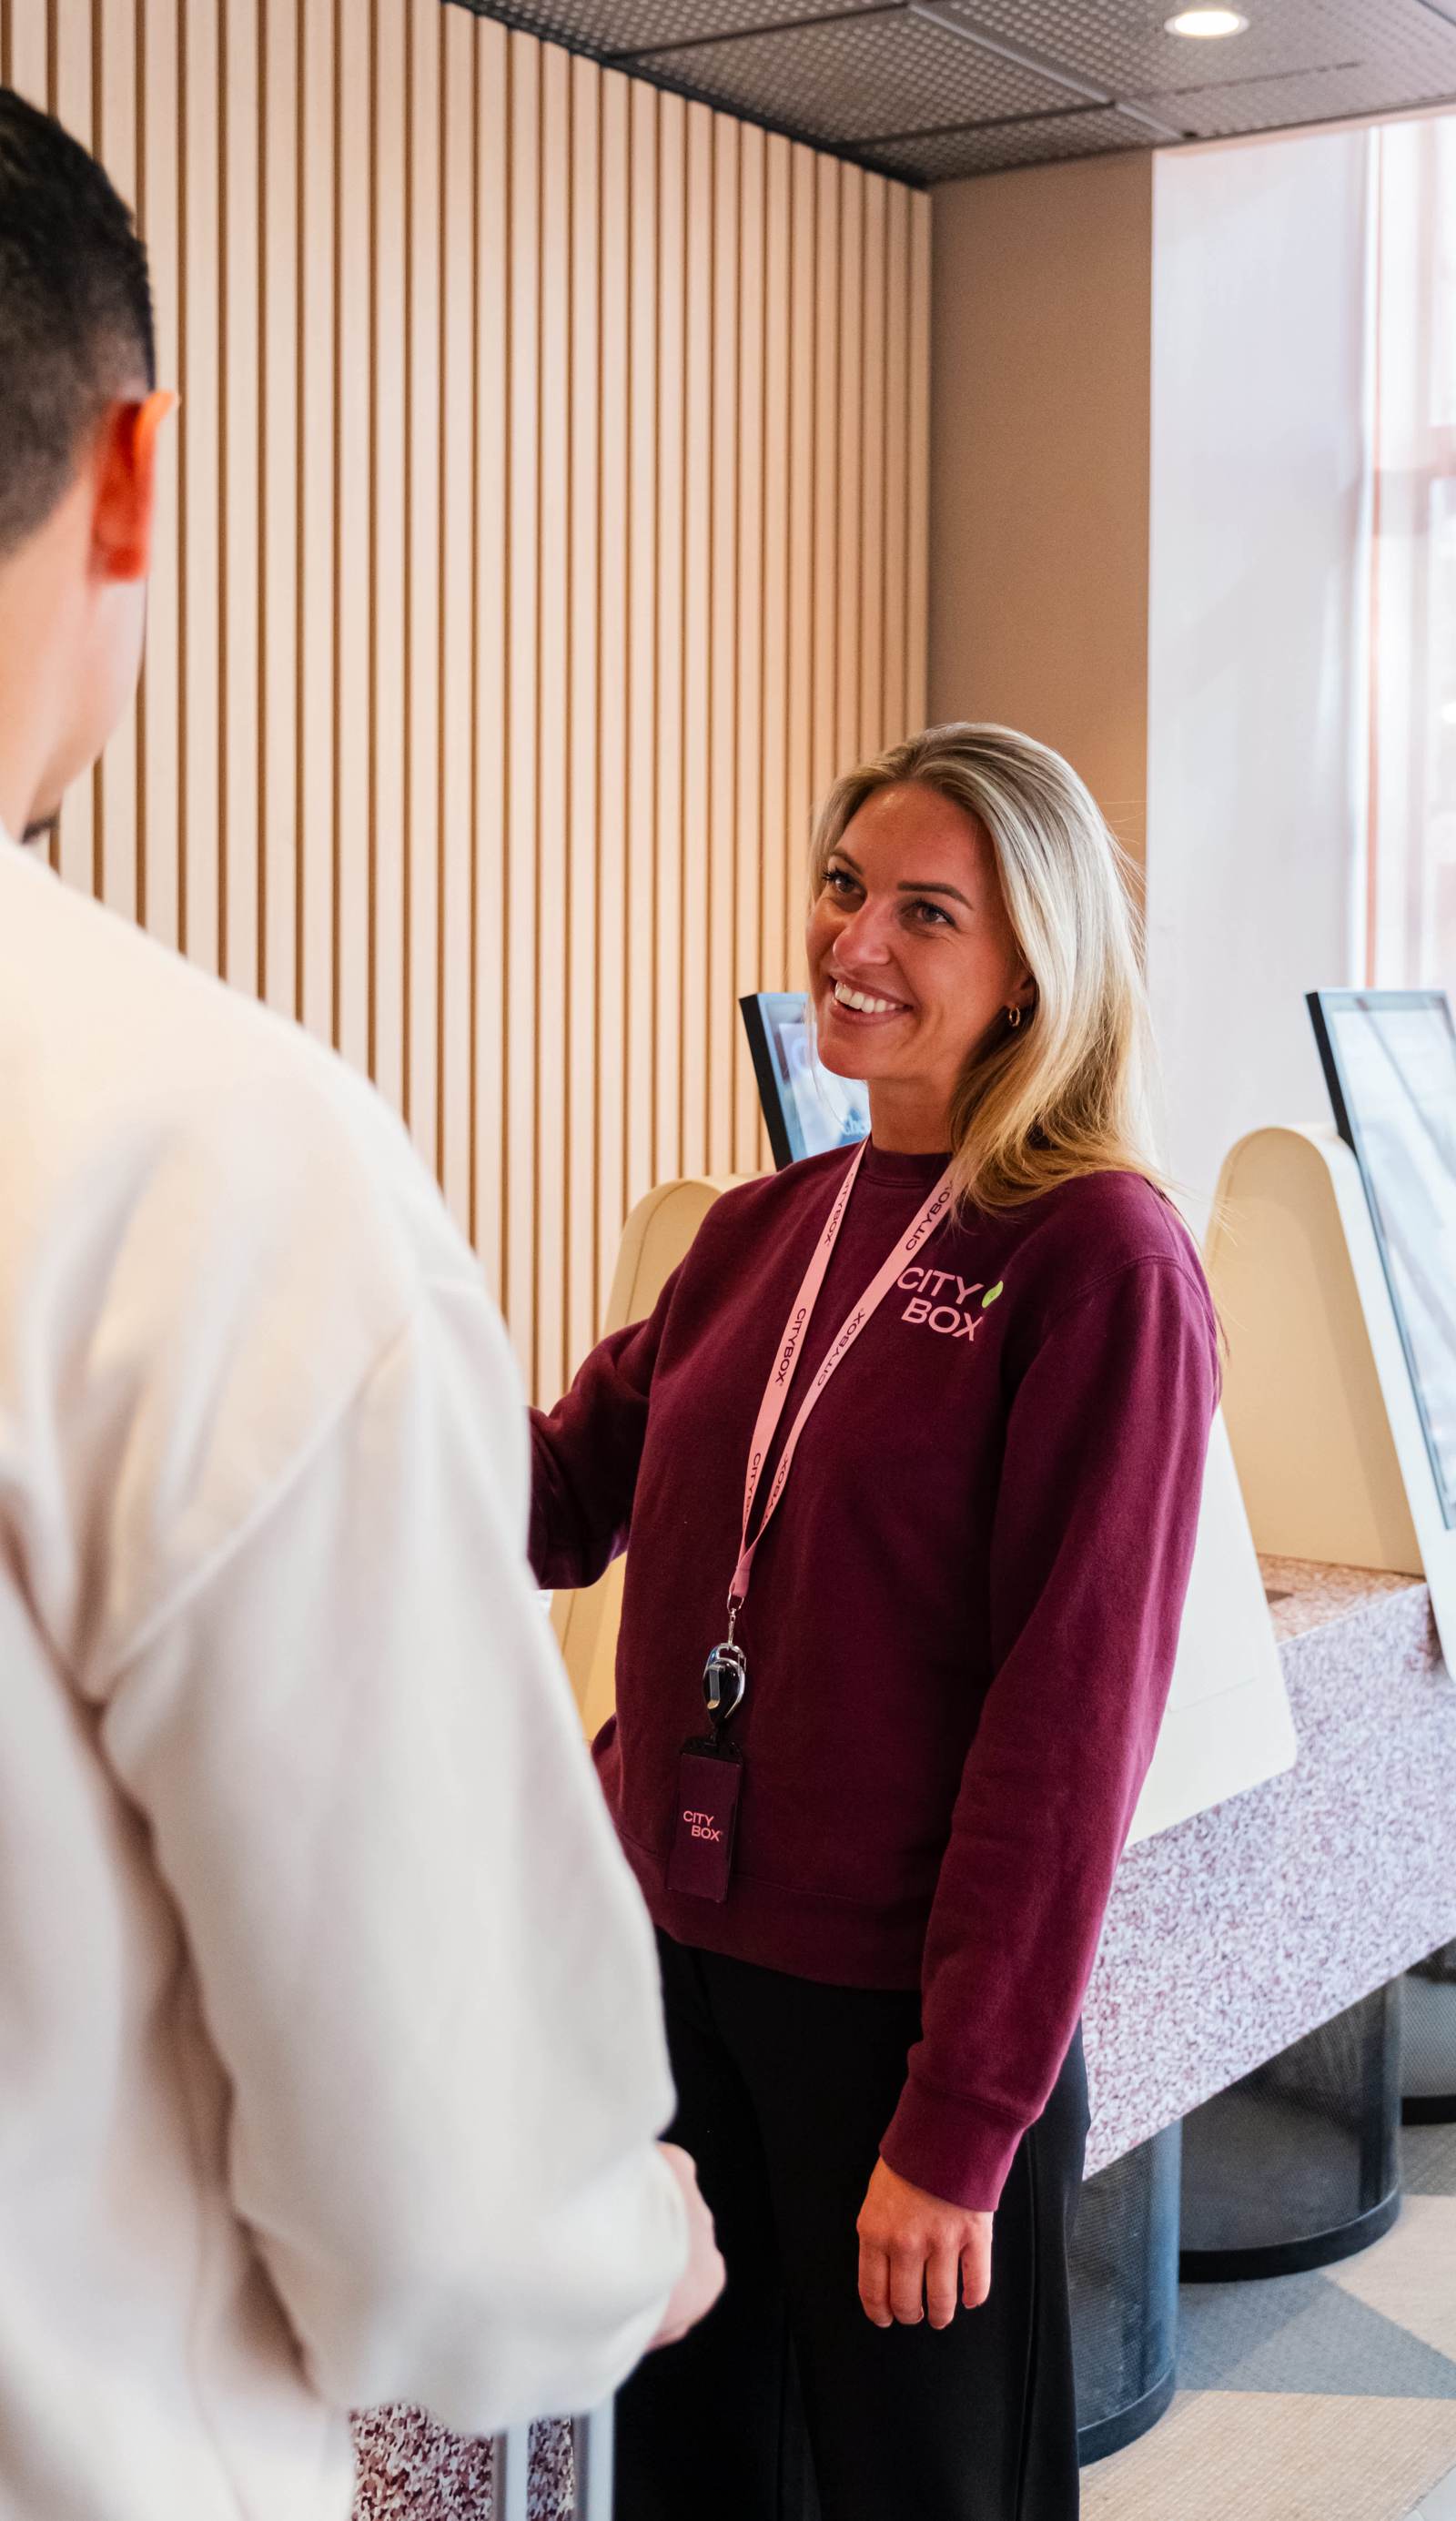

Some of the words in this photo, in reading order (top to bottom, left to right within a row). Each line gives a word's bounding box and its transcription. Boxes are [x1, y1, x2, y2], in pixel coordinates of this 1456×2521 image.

[897, 1267, 984, 1305] CITY
[901, 1297, 983, 1341] BOX
[775, 1308, 806, 1383] CITYBOX
[817, 1311, 865, 1386] CITYBOX
[683, 1810, 714, 1827] CITY
[692, 1825, 721, 1842] BOX
